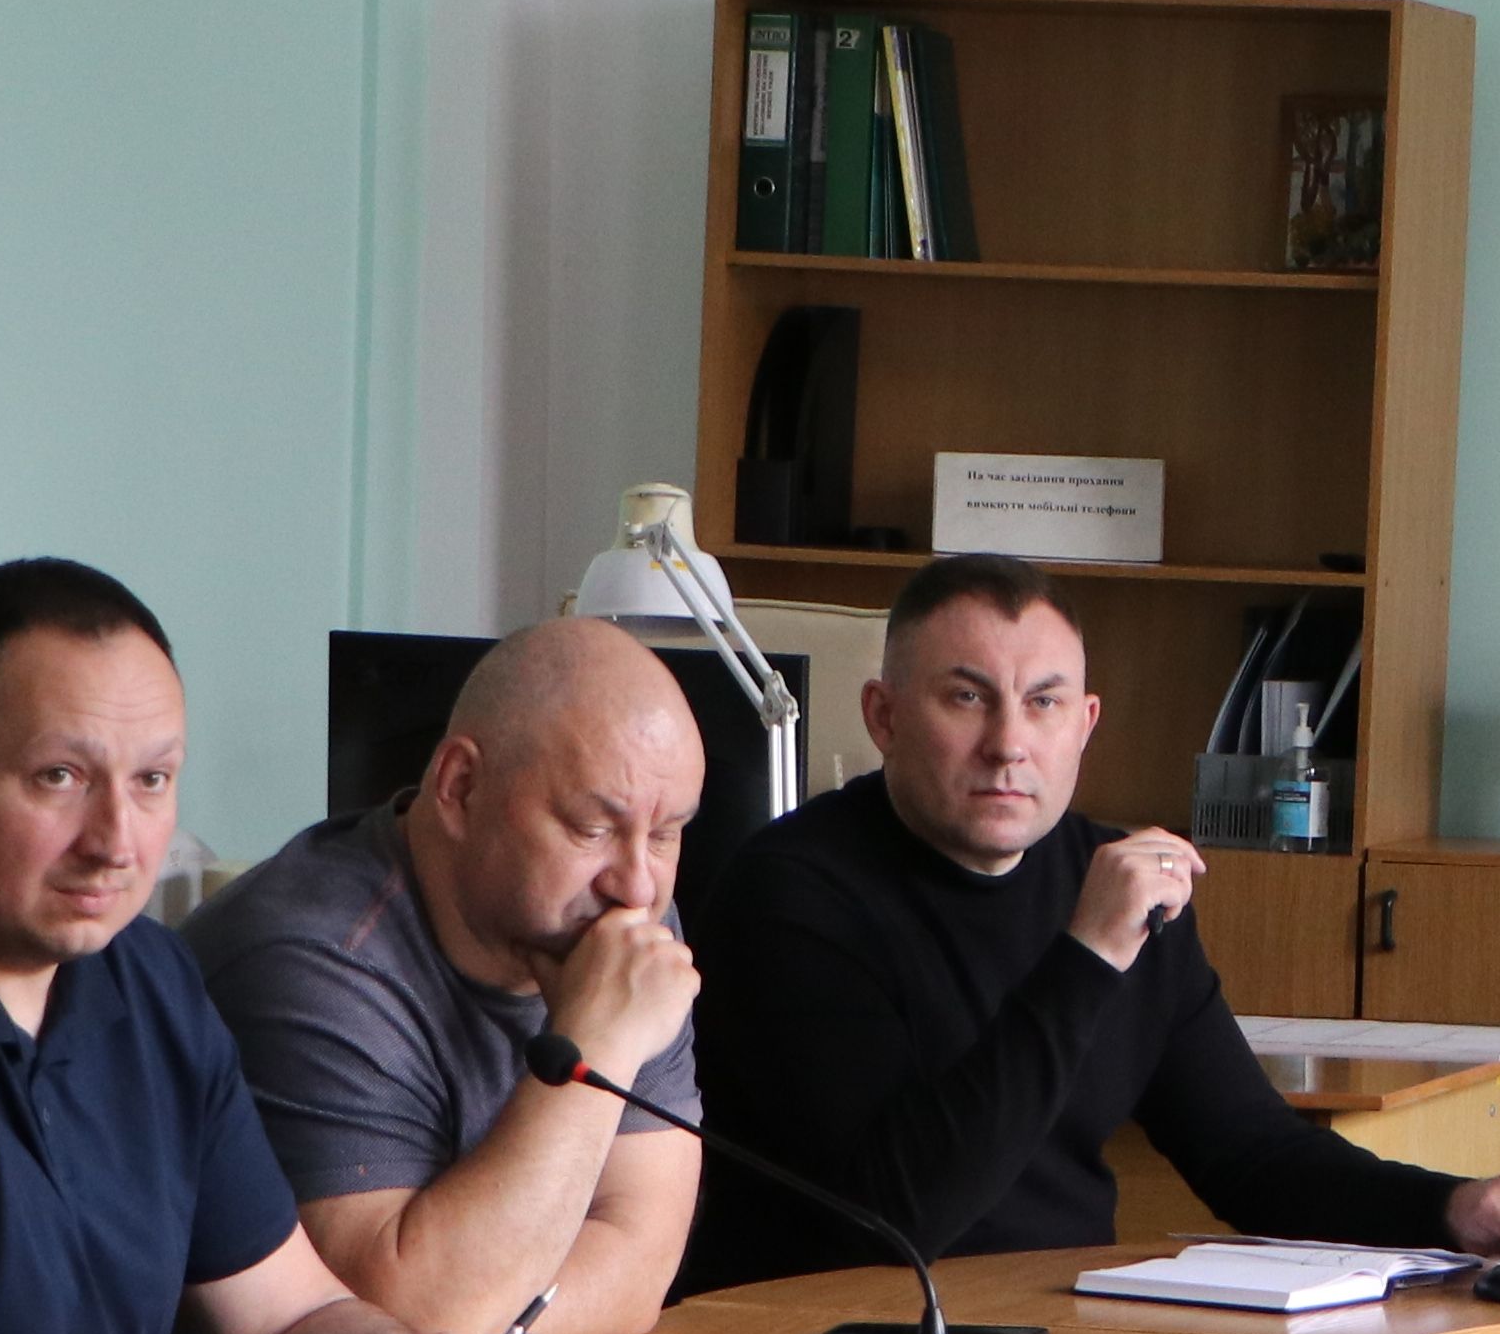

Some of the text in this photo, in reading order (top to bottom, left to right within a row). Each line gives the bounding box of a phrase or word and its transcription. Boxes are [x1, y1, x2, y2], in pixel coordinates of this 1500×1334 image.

[838, 30, 853, 48] 2
[967, 470, 1125, 487] На час засідання прохання
[966, 500, 1137, 517] вимкнути мобільні телефони
